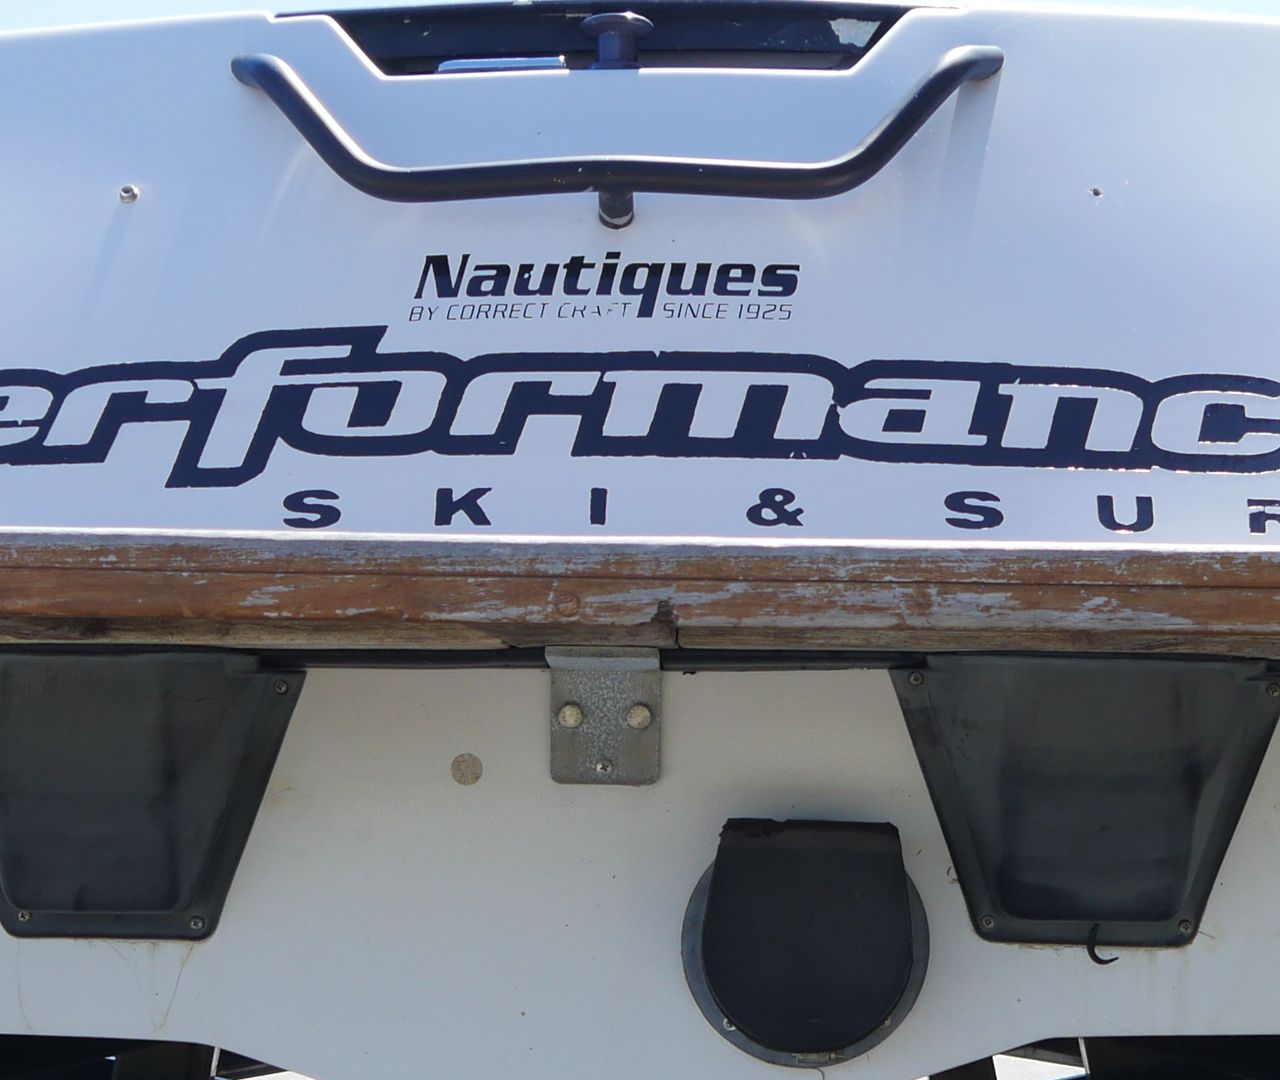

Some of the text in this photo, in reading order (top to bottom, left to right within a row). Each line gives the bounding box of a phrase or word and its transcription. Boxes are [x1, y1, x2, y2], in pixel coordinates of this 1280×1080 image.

[413, 251, 801, 319] Nautiques
[408, 306, 439, 322] BY
[446, 303, 550, 321] CORRECT
[663, 302, 729, 320] SINCE
[737, 303, 794, 320] 1925
[282, 488, 609, 529] SKI
[745, 487, 804, 527] &
